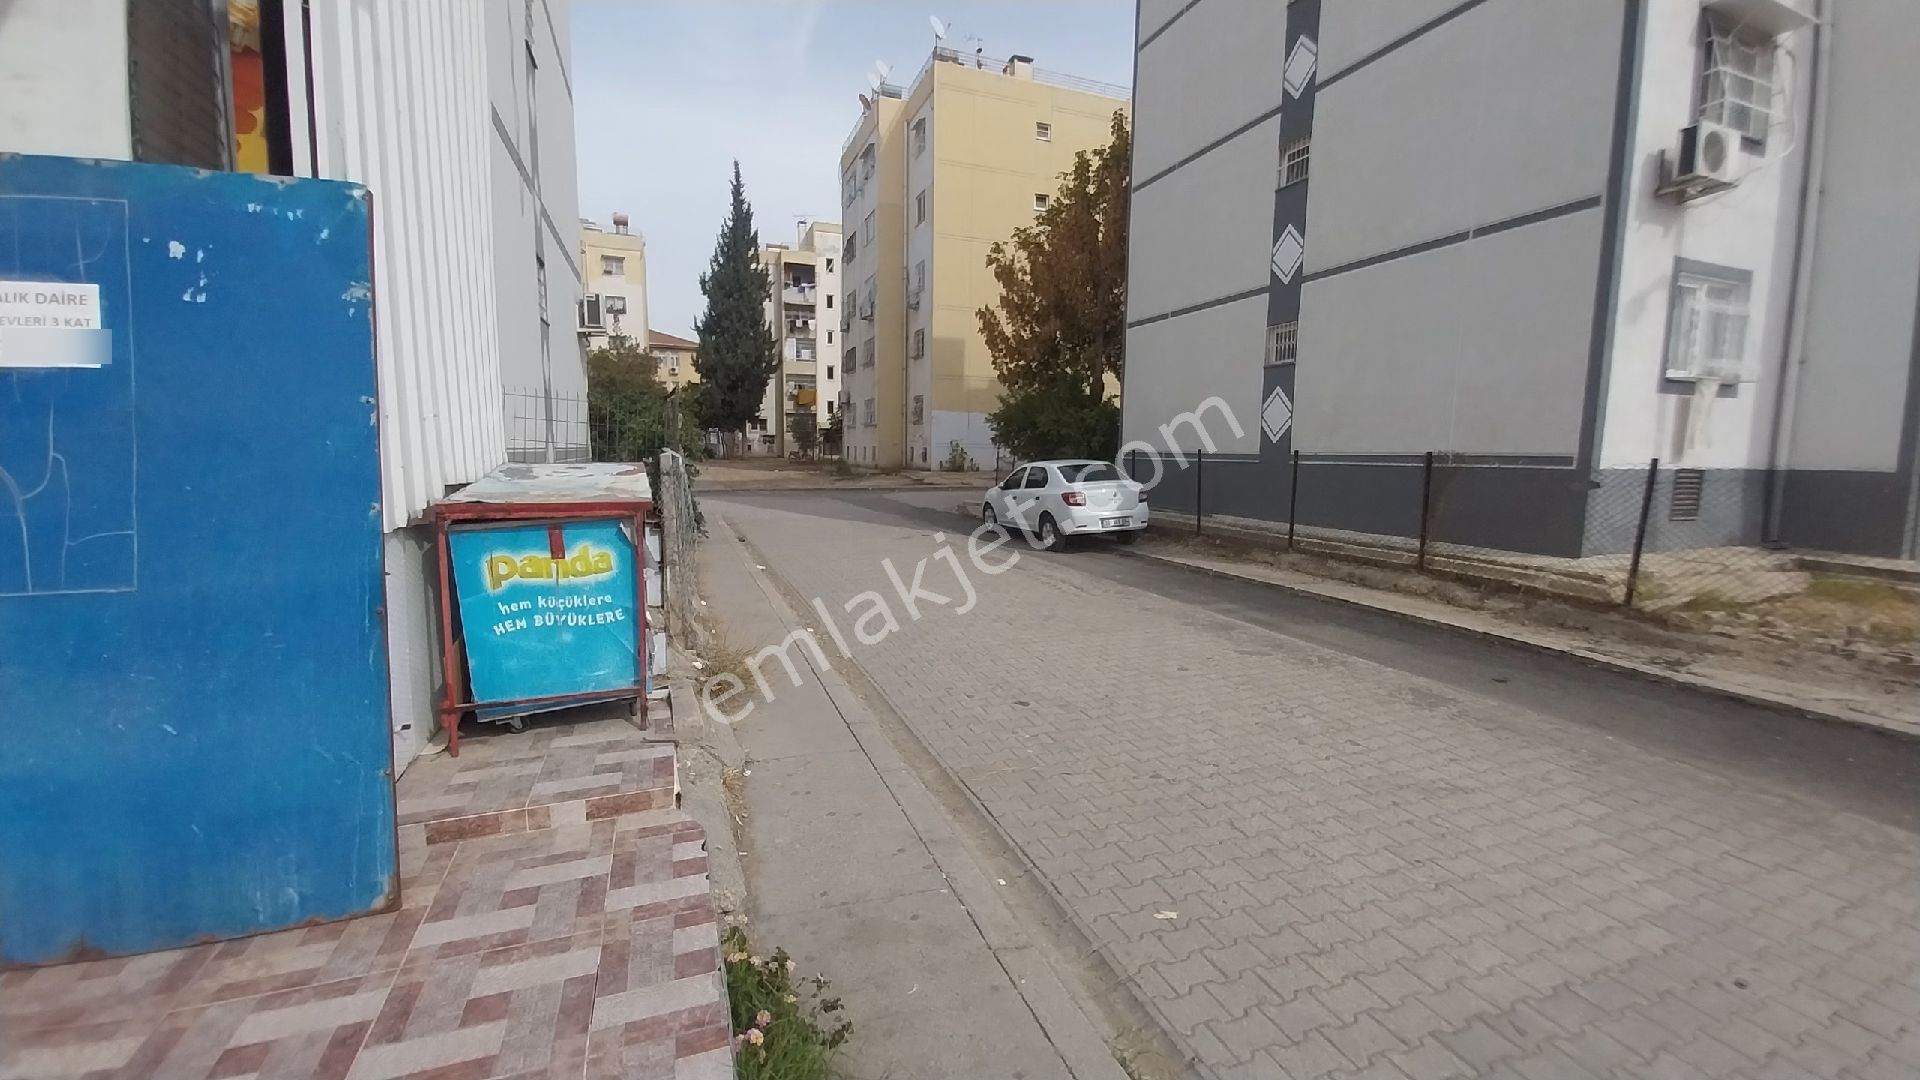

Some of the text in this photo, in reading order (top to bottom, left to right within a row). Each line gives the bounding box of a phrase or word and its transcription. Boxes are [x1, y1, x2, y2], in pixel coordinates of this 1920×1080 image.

[35, 290, 89, 306] DAİRE
[51, 317, 60, 328] 3
[64, 317, 92, 329] KAT
[485, 544, 614, 591] panda
[497, 593, 613, 616] hem küçüklere
[492, 607, 626, 637] HEM BÜYÜKLERE
